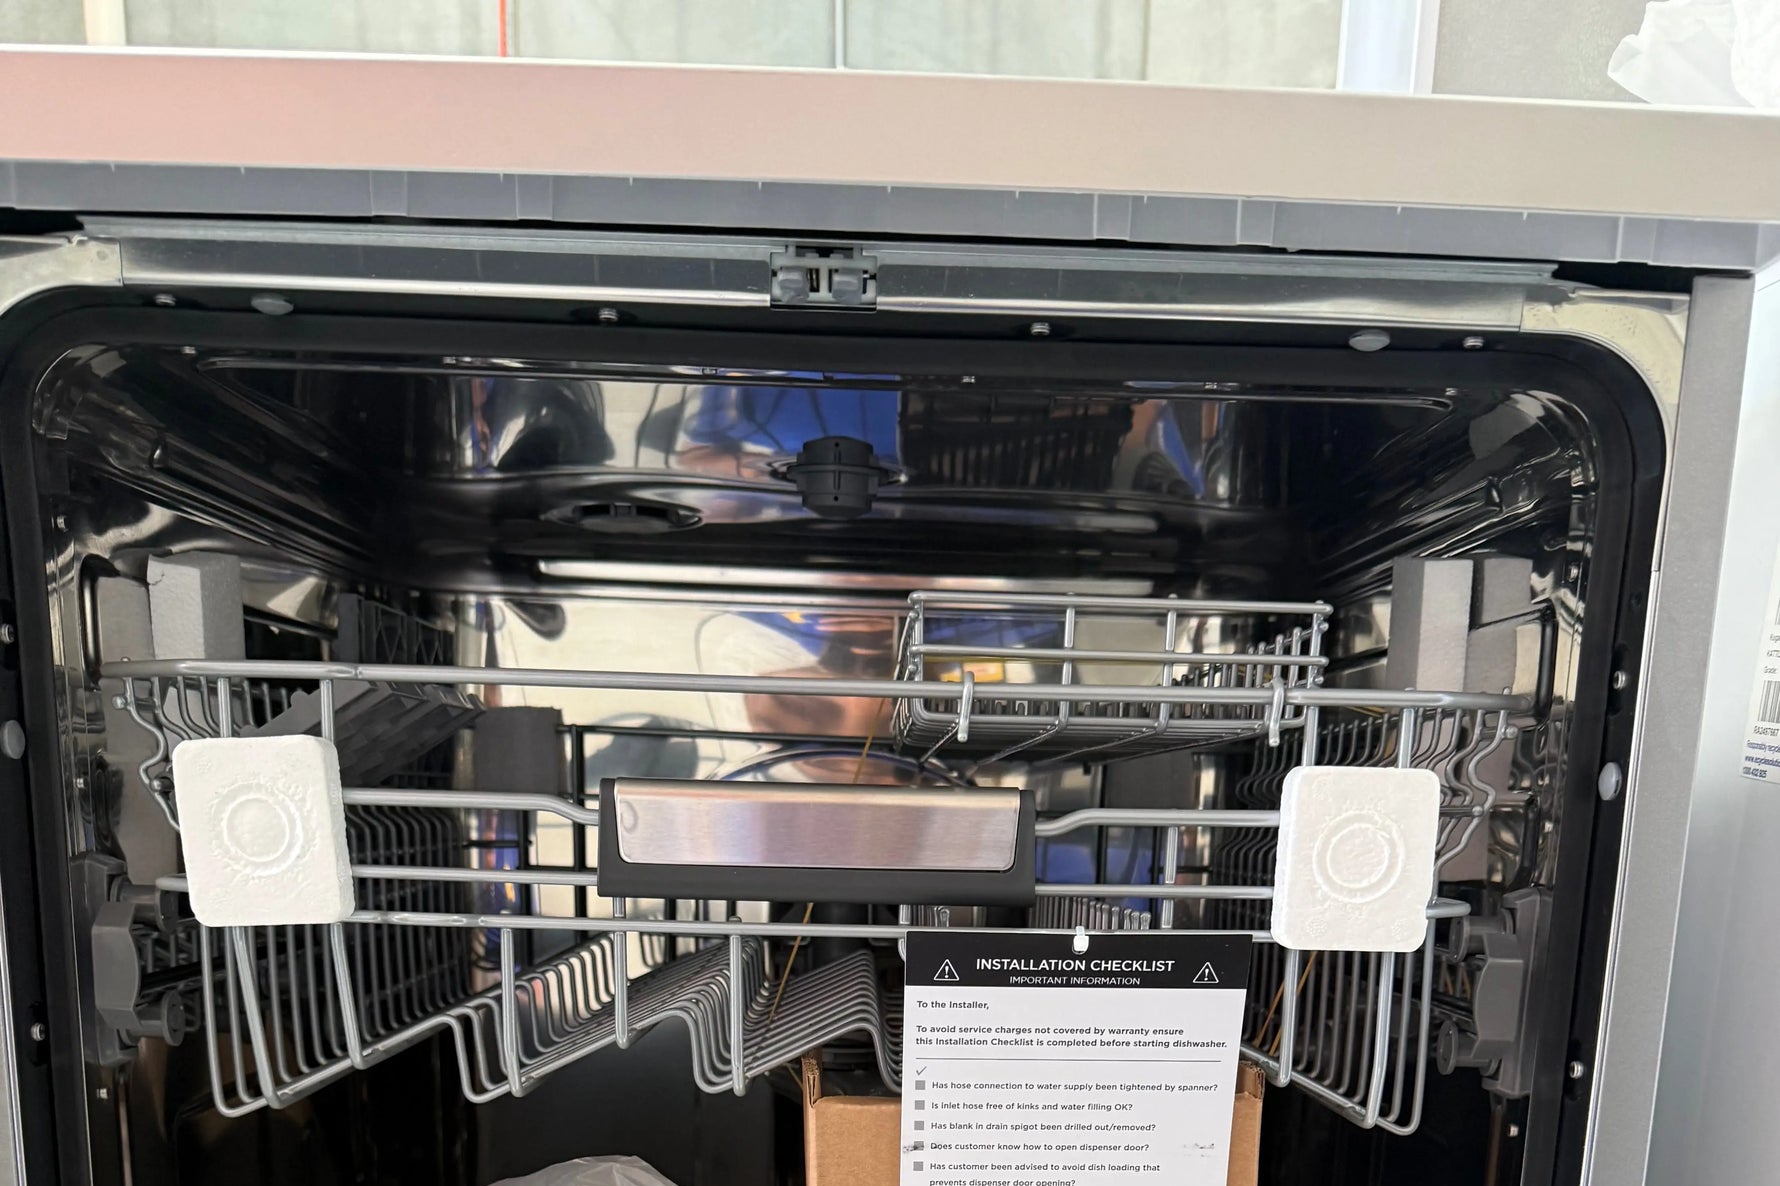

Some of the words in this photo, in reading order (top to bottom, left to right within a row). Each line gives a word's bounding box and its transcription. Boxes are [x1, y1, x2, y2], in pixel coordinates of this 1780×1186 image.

[976, 958, 1086, 971] INSTALLATION
[1090, 959, 1175, 972] CHECKLIST
[1009, 976, 1068, 984] IMPORTANT
[1070, 976, 1140, 985] INFORMATION
[916, 1000, 928, 1008] To
[930, 1000, 946, 1008] the
[949, 1000, 989, 1010] Installer,
[929, 1025, 956, 1033] avoid
[958, 1025, 992, 1033] service
[994, 1025, 1032, 1035] charges
[1034, 1026, 1050, 1034] not
[1052, 1026, 1091, 1034] covered
[1093, 1026, 1105, 1036] by
[1107, 1027, 1150, 1036] warranty
[915, 1037, 933, 1045] this
[935, 1037, 988, 1046] Installation
[990, 1038, 1034, 1046] Checklist
[1036, 1038, 1044, 1046] is
[1046, 1038, 1097, 1047] completed
[1099, 1038, 1131, 1047] before
[1133, 1039, 1170, 1049] starting
[1172, 1039, 1227, 1048] dishwasher.
[932, 1081, 948, 1089] Has
[950, 1081, 971, 1089] hose
[973, 1082, 1023, 1090] connection
[1024, 1082, 1034, 1090] to
[1063, 1083, 1093, 1091] supply
[1095, 1082, 1117, 1091] been
[1119, 1083, 1162, 1092] tightened
[1164, 1083, 1176, 1092] by
[1177, 1083, 1218, 1092] spanner?
[931, 1101, 938, 1109] Is
[941, 1101, 960, 1109] inlet
[962, 1102, 983, 1110] hose
[985, 1102, 1003, 1110] free
[1005, 1102, 1015, 1110] of
[1016, 1102, 1039, 1110] kinks
[1041, 1102, 1058, 1110] and
[1087, 1103, 1112, 1112] filling
[1114, 1103, 1133, 1111] OK?
[930, 1122, 947, 1130] Has
[949, 1122, 973, 1130] blank
[975, 1122, 983, 1130] in
[985, 1122, 1008, 1130] drain
[1010, 1122, 1038, 1132] spigot
[1064, 1123, 1092, 1131] drilled
[1094, 1122, 1156, 1131] out/removed?
[930, 1142, 953, 1150] Does
[997, 1142, 1021, 1150] know
[1043, 1143, 1053, 1151] to
[1055, 1144, 1077, 1152] open
[1079, 1143, 1122, 1152] dispenser
[1123, 1143, 1150, 1151] door?
[929, 1162, 946, 1170] Has
[990, 1163, 1012, 1171] been
[1014, 1162, 1048, 1171] advised
[1061, 1163, 1086, 1171] avoid
[1087, 1163, 1106, 1171] dish
[1107, 1163, 1140, 1173] loading
[929, 1179, 967, 1186] prevents
[968, 1178, 1011, 1186] dispenser
[1012, 1179, 1034, 1186] door
